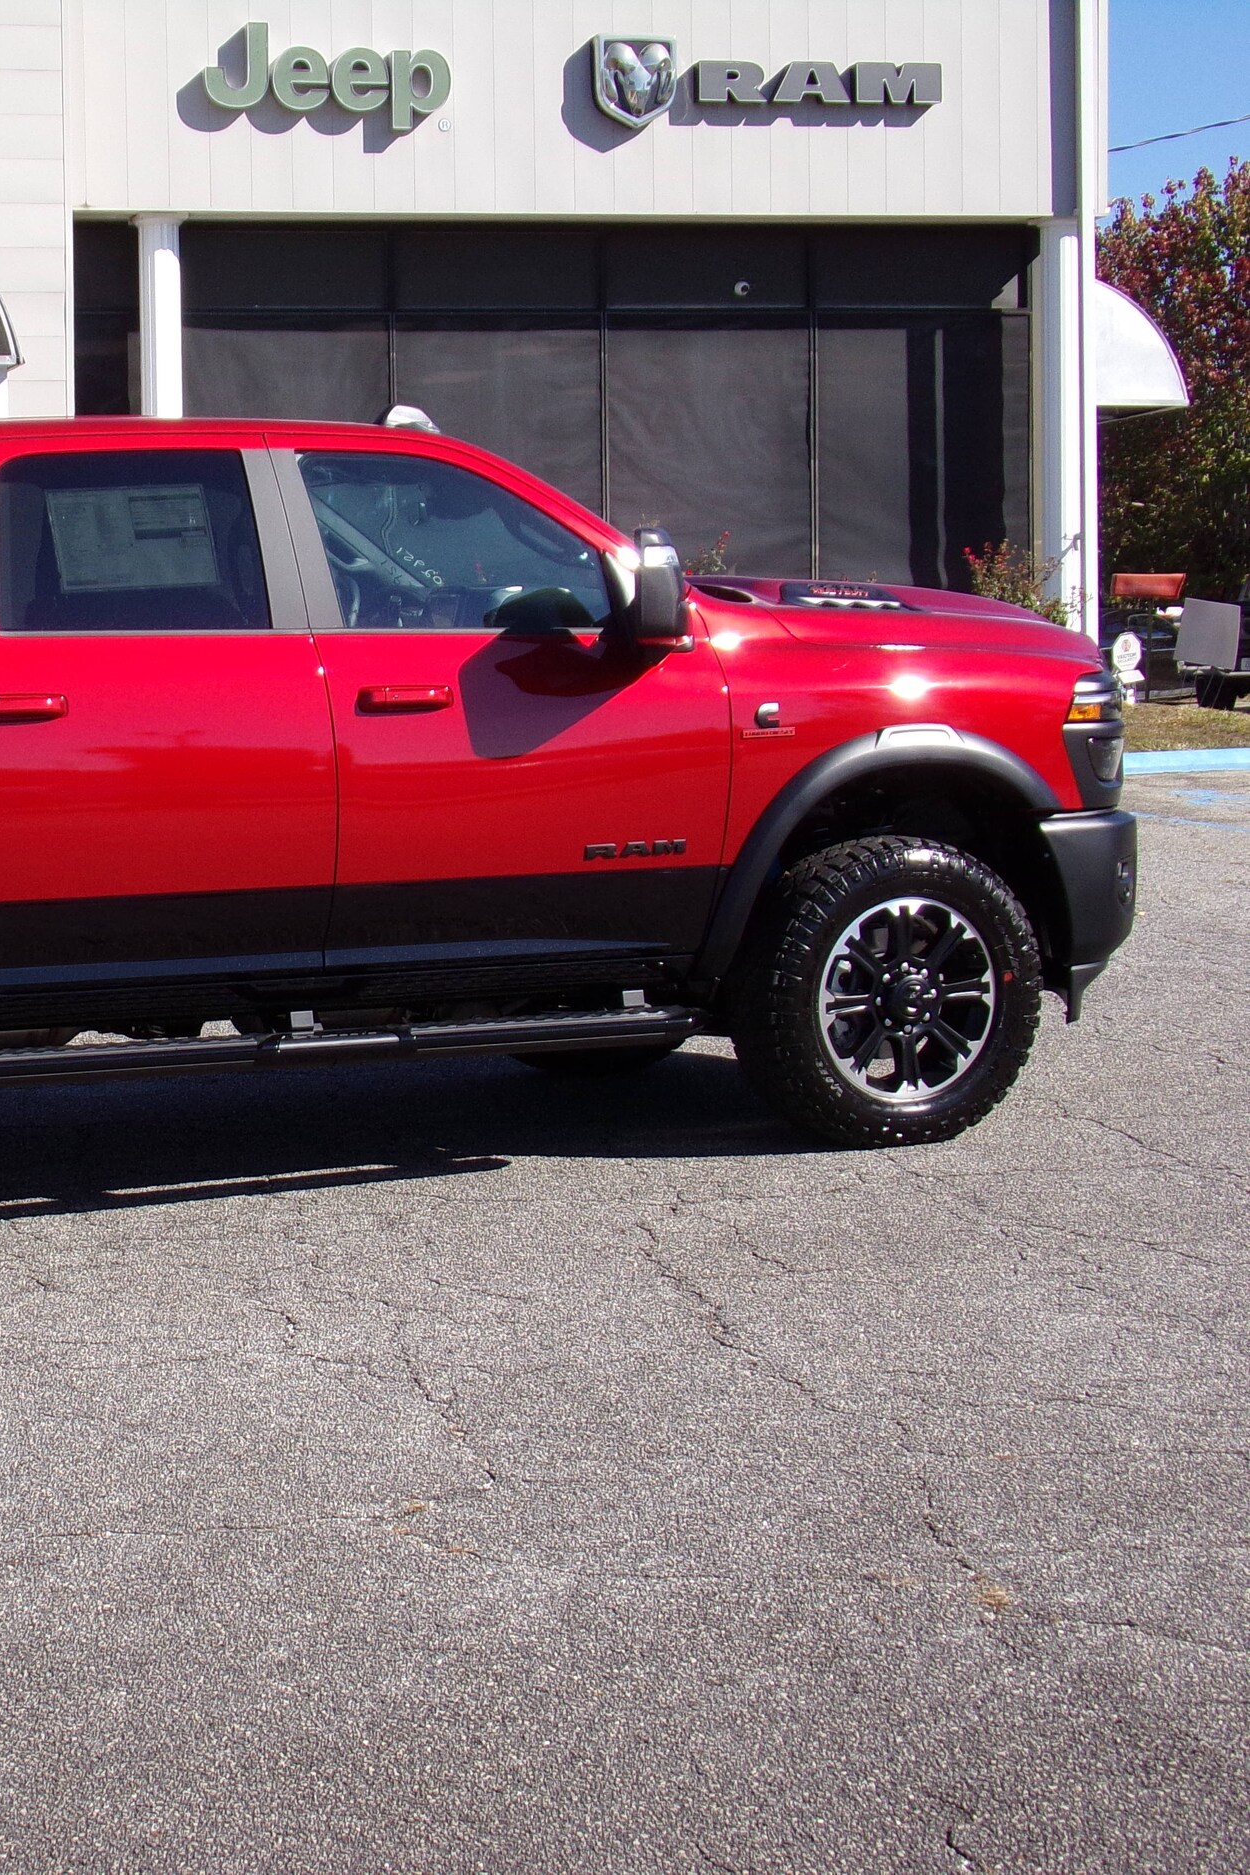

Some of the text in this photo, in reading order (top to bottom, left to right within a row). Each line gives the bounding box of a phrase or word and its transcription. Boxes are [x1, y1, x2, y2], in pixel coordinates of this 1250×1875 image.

[204, 22, 452, 131] Jeep
[694, 60, 943, 105] RAM
[583, 838, 687, 861] RAM
